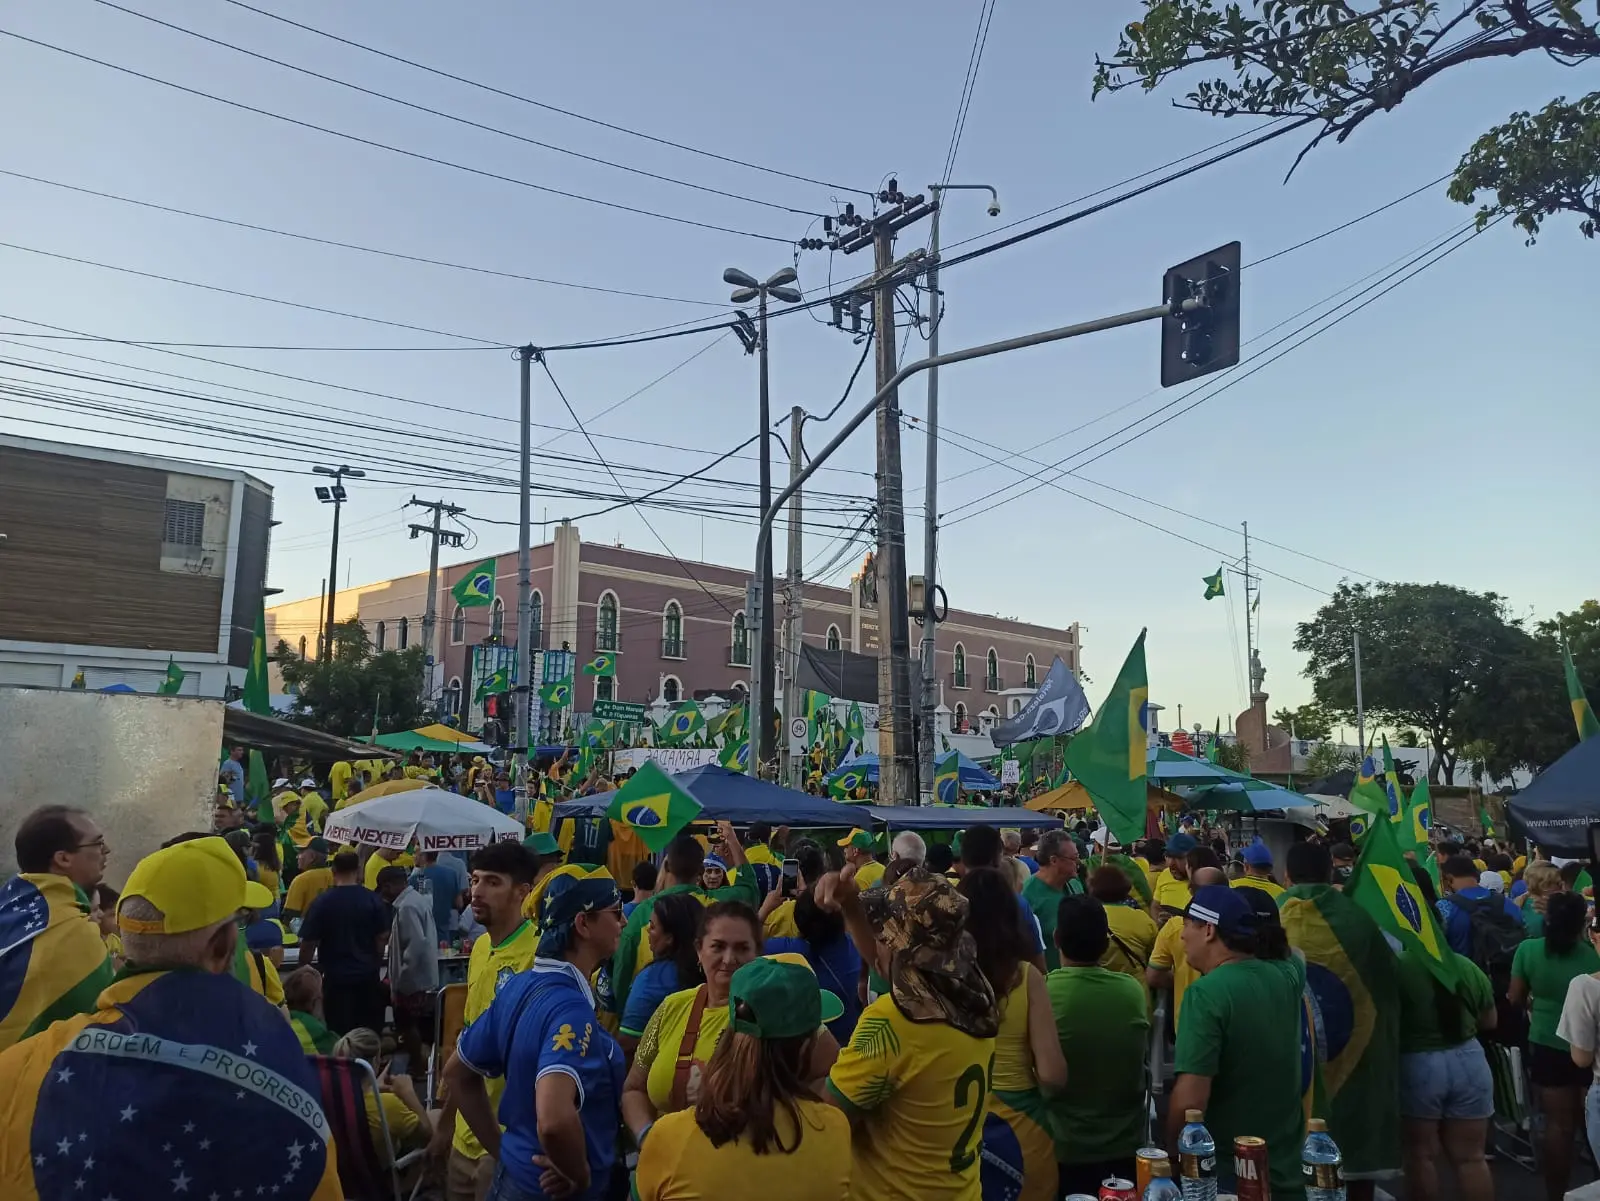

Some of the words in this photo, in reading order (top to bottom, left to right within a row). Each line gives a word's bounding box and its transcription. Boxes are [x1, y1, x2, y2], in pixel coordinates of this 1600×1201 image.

[353, 826, 406, 847] NEXTEL
[424, 834, 485, 849] NEXTEL
[578, 1022, 592, 1057] vivo
[75, 1032, 162, 1057] ORDEM
[179, 1046, 188, 1058] E
[201, 1050, 324, 1129] PROGRESSO
